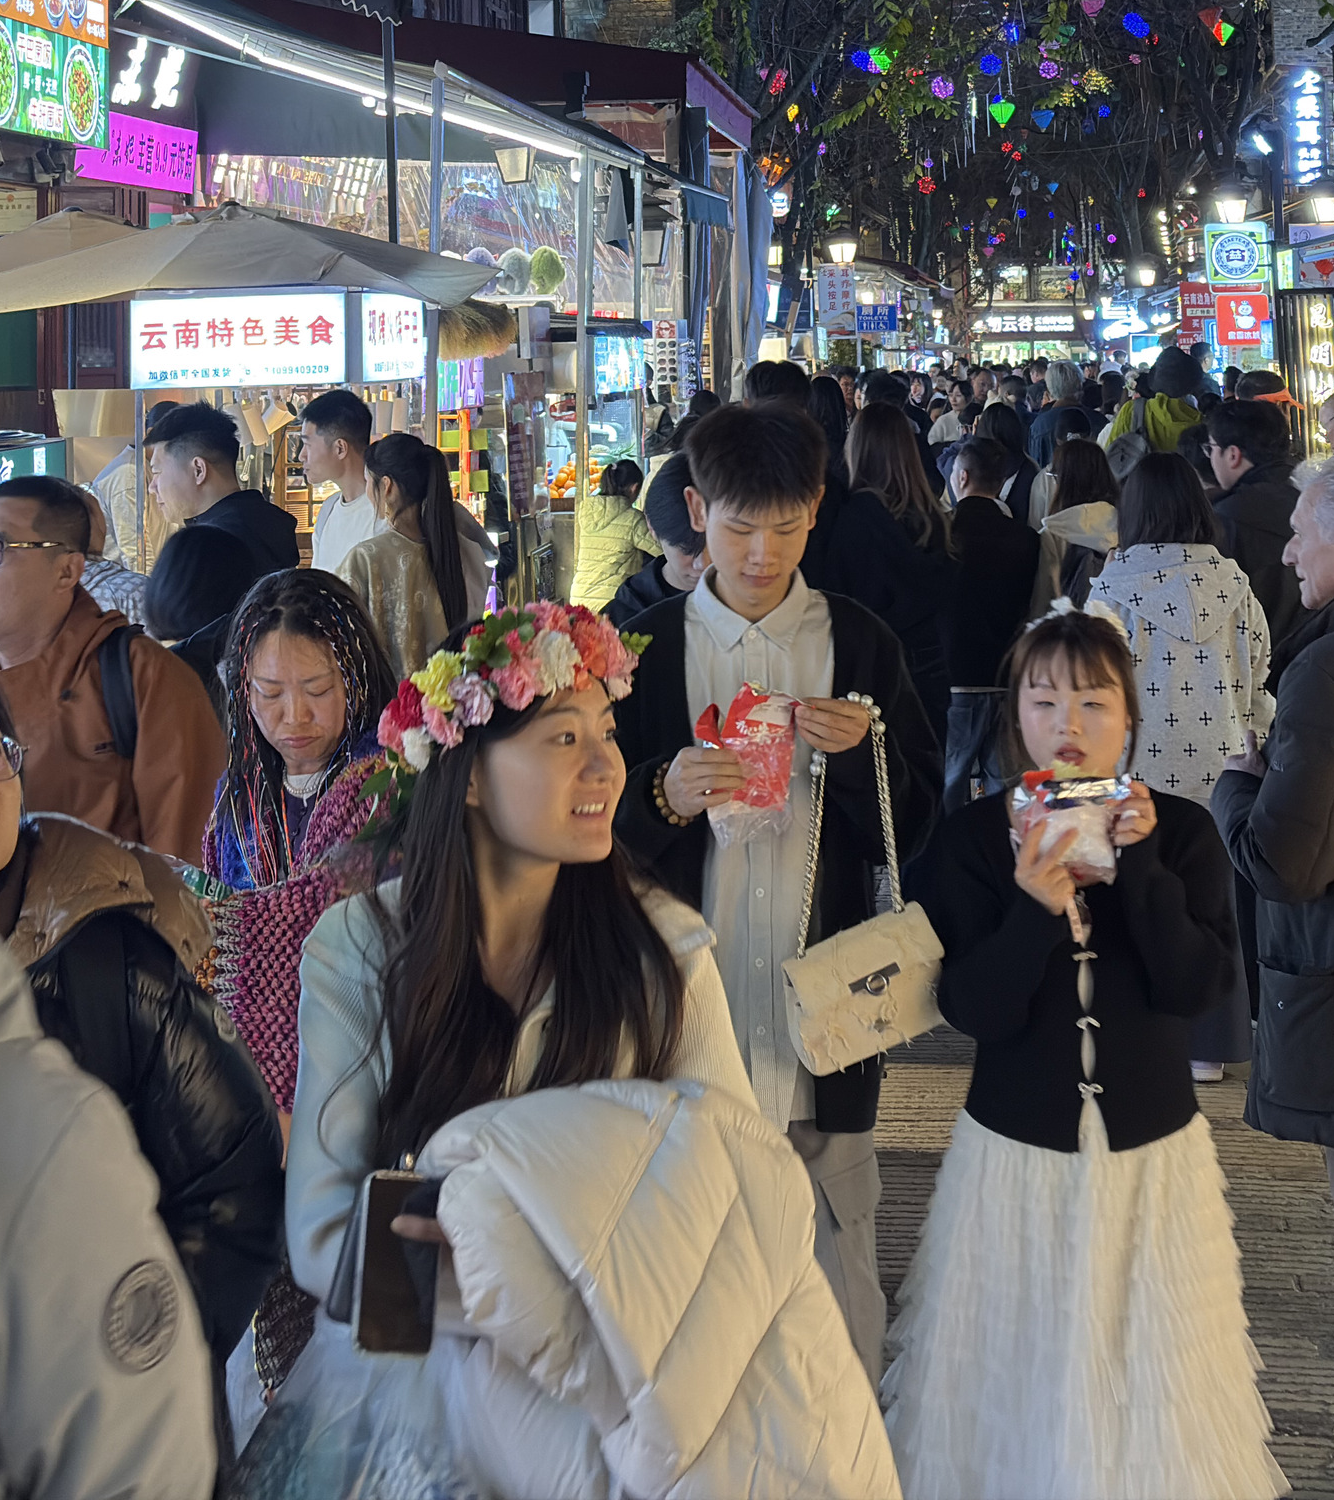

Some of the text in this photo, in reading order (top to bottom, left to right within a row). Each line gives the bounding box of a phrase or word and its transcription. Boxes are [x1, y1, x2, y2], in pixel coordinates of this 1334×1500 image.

[861, 306, 889, 316] 厕所
[140, 314, 335, 351] 云南特色美食
[148, 367, 232, 381] 加微信可全国发货
